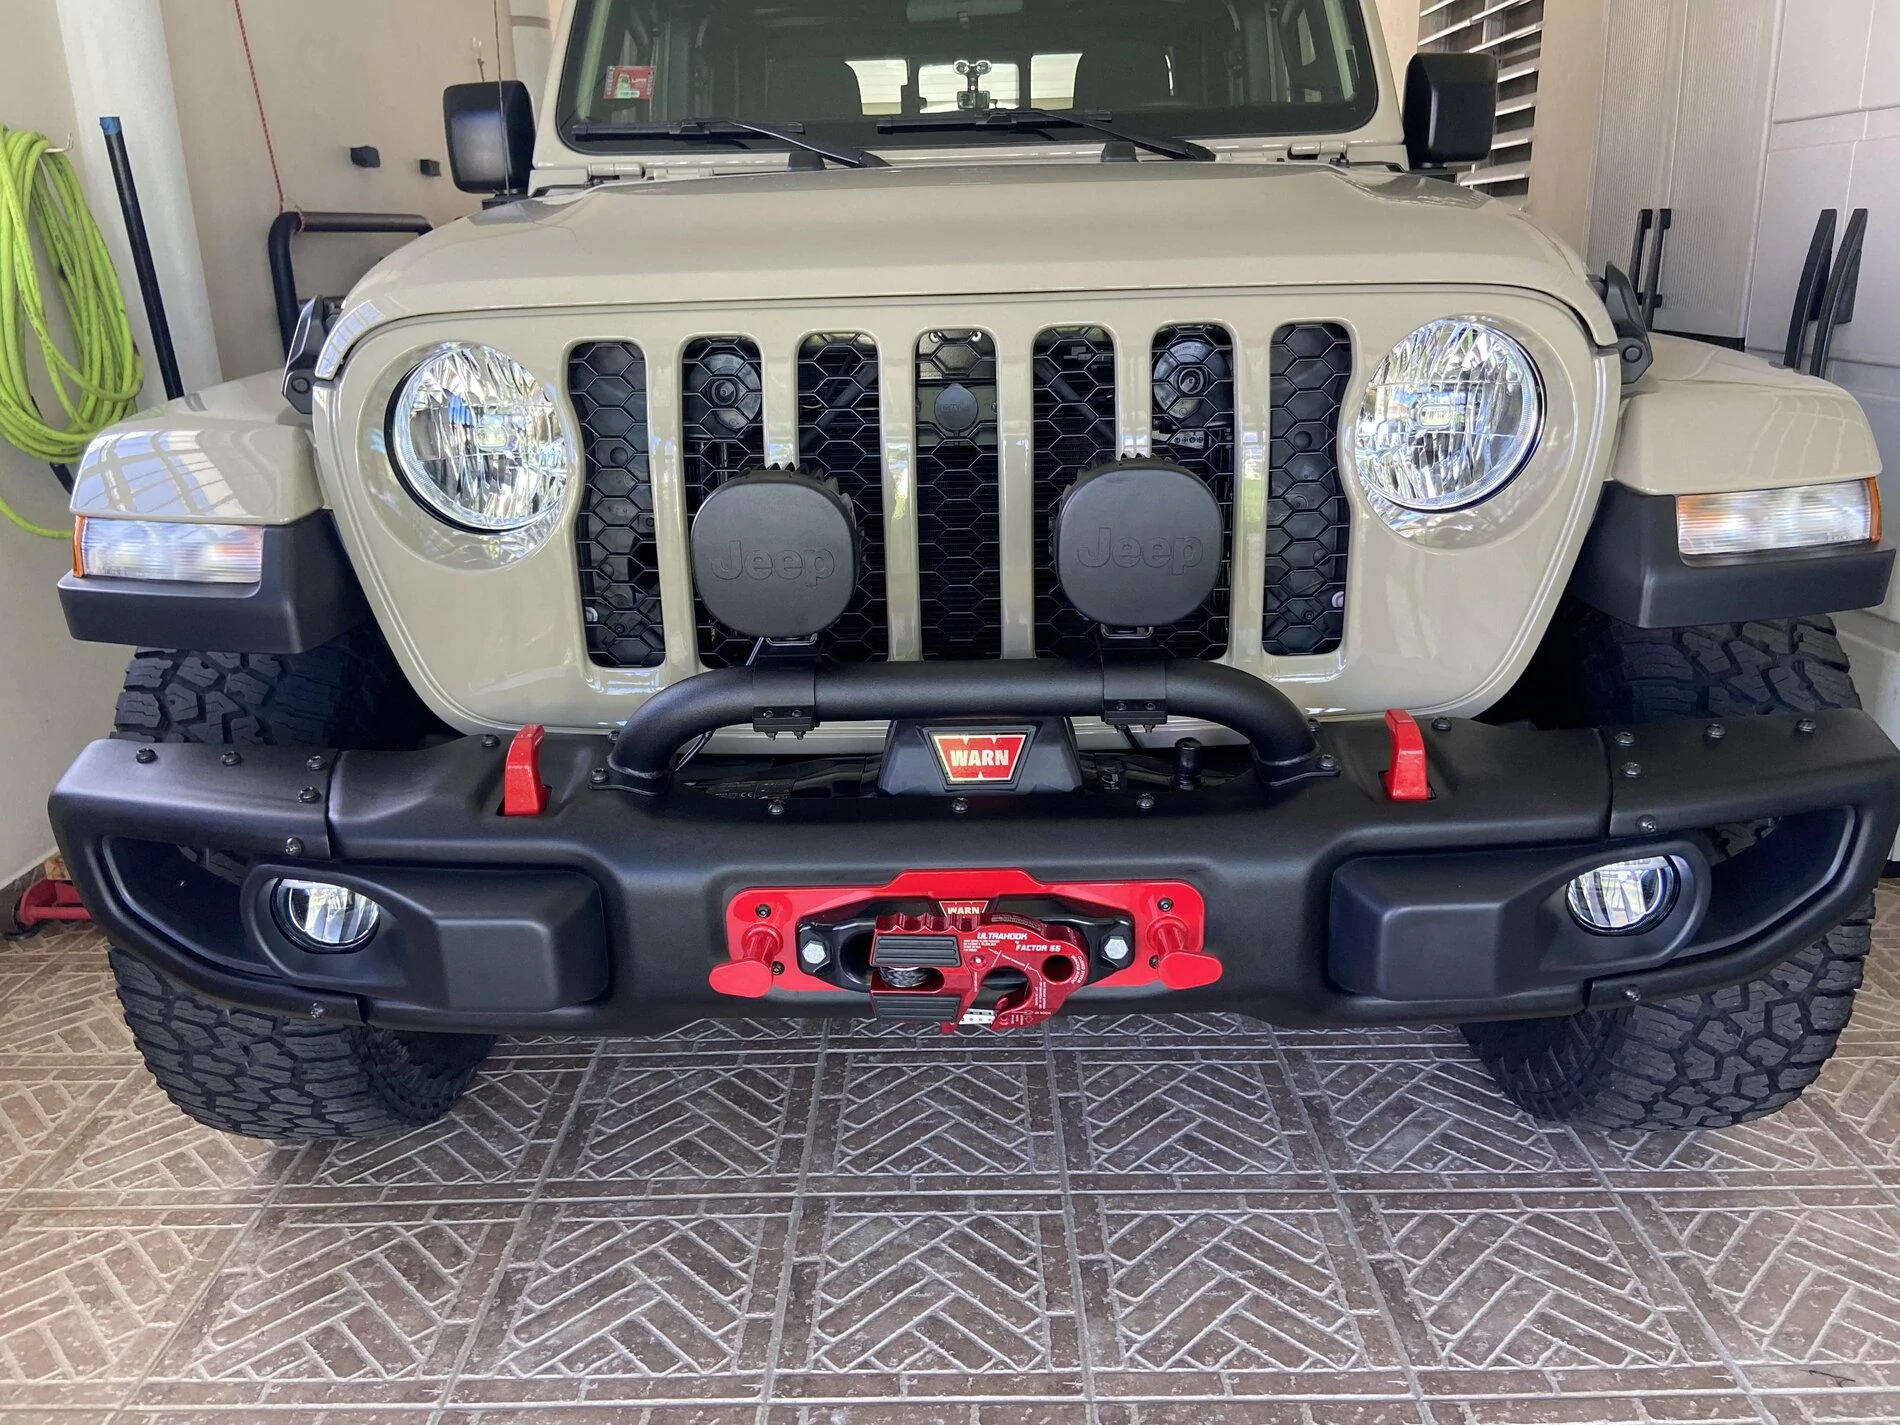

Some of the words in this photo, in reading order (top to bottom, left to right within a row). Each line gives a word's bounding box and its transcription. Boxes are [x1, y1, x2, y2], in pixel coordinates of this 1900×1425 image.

[1076, 527, 1204, 576] Jeep
[709, 539, 836, 588] Jeep
[950, 749, 1009, 767] WARN
[947, 906, 980, 915] WARN
[977, 932, 1028, 940] ULTRAHOOK
[1015, 944, 1047, 952] FACTOR
